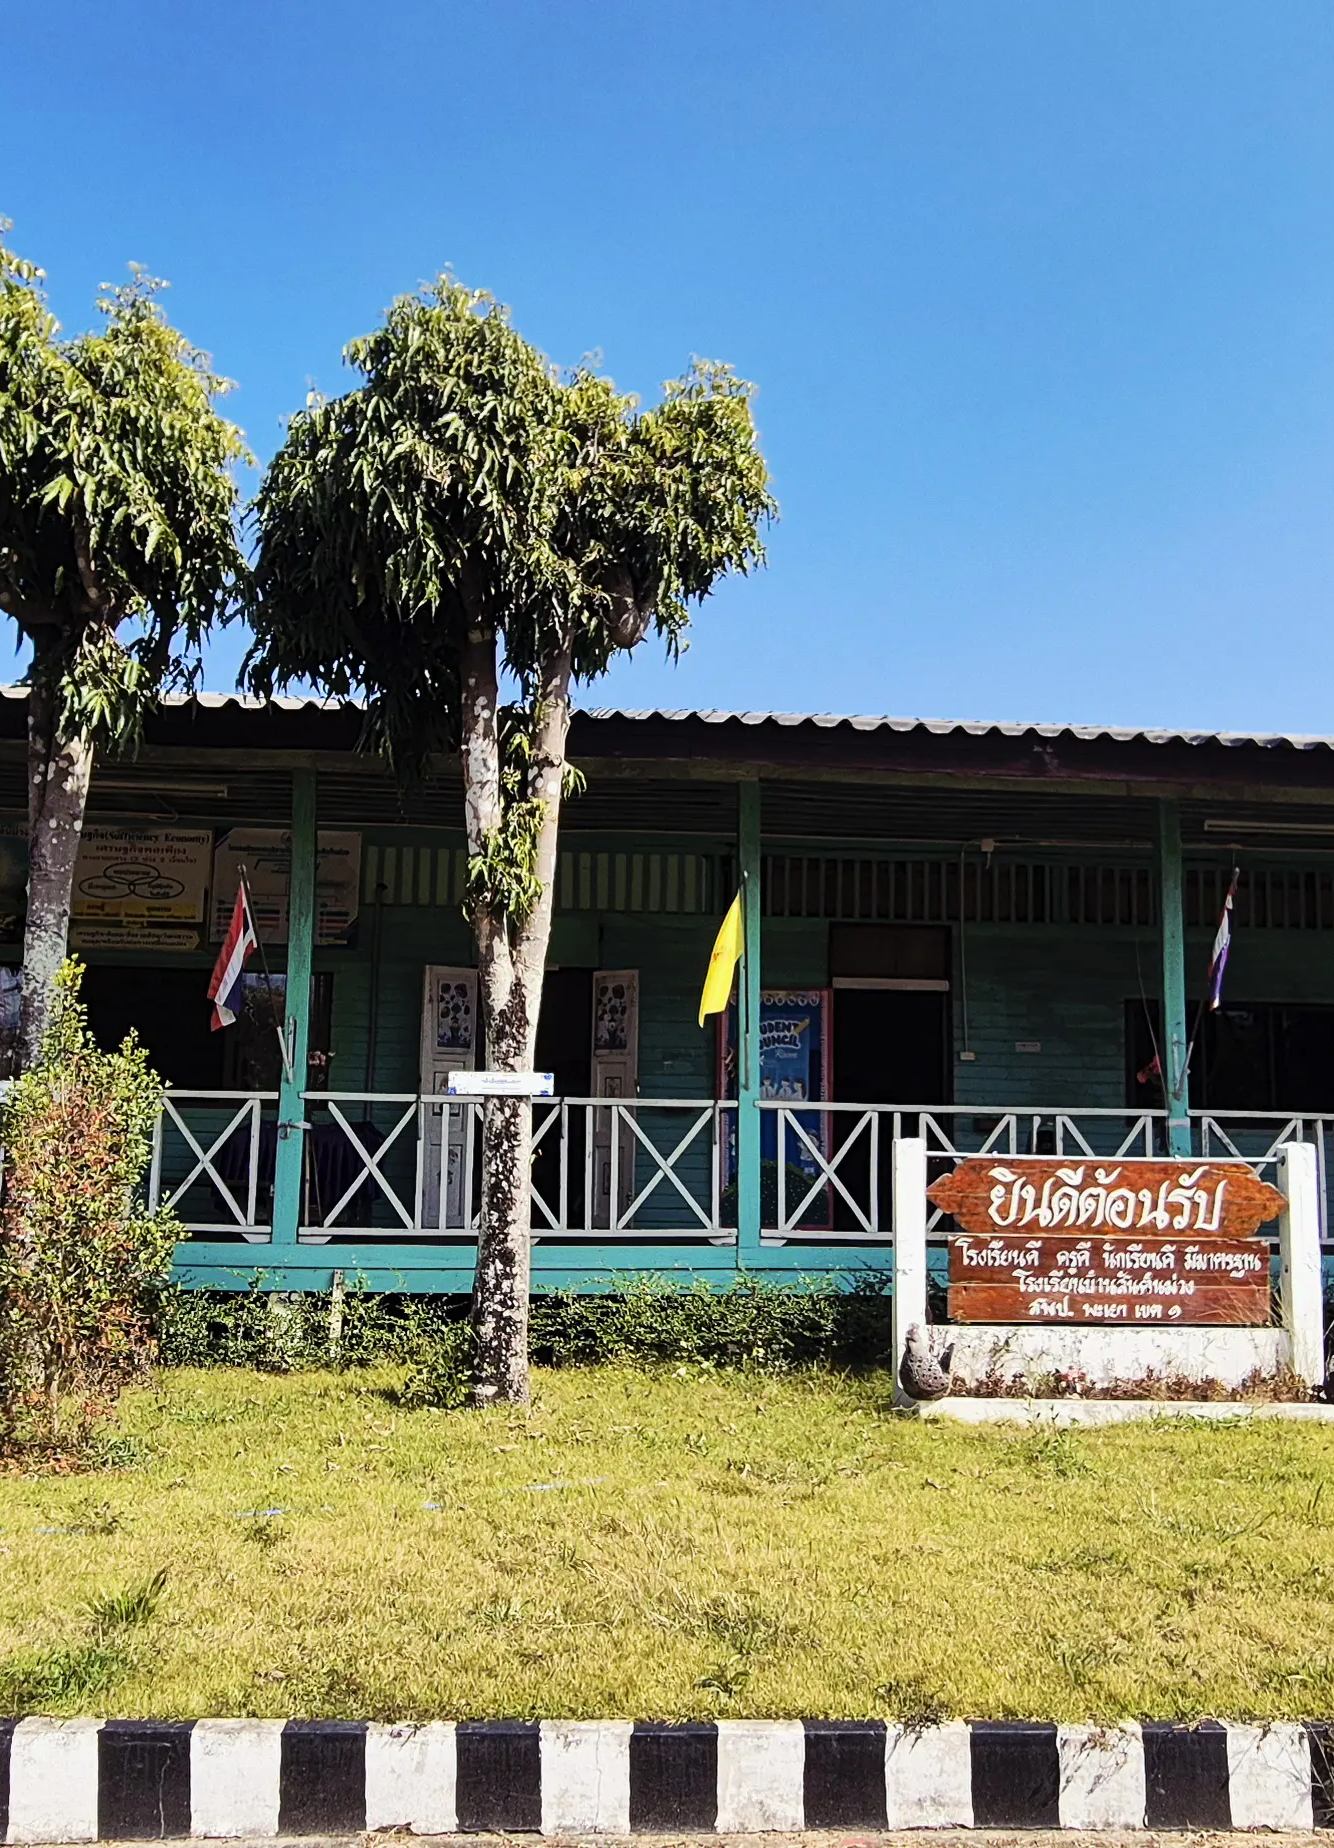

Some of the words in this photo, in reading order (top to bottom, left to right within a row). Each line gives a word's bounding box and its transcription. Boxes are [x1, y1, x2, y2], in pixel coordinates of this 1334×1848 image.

[759, 1021, 800, 1036] UDENT
[759, 1034, 800, 1050] UNCIL
[988, 1166, 1228, 1230] ยินดีต้อนรับ
[955, 1238, 1042, 1267] โรงเรียนดี
[1056, 1241, 1092, 1275] ครูดี
[1102, 1241, 1177, 1270] นักเรียนดี
[1183, 1245, 1263, 1278] มีมาตรฐาน
[1028, 1295, 1075, 1318] สพป.
[1082, 1302, 1128, 1319] พะเยา
[1134, 1303, 1163, 1319] เขต
[1167, 1304, 1183, 1320] ๑
